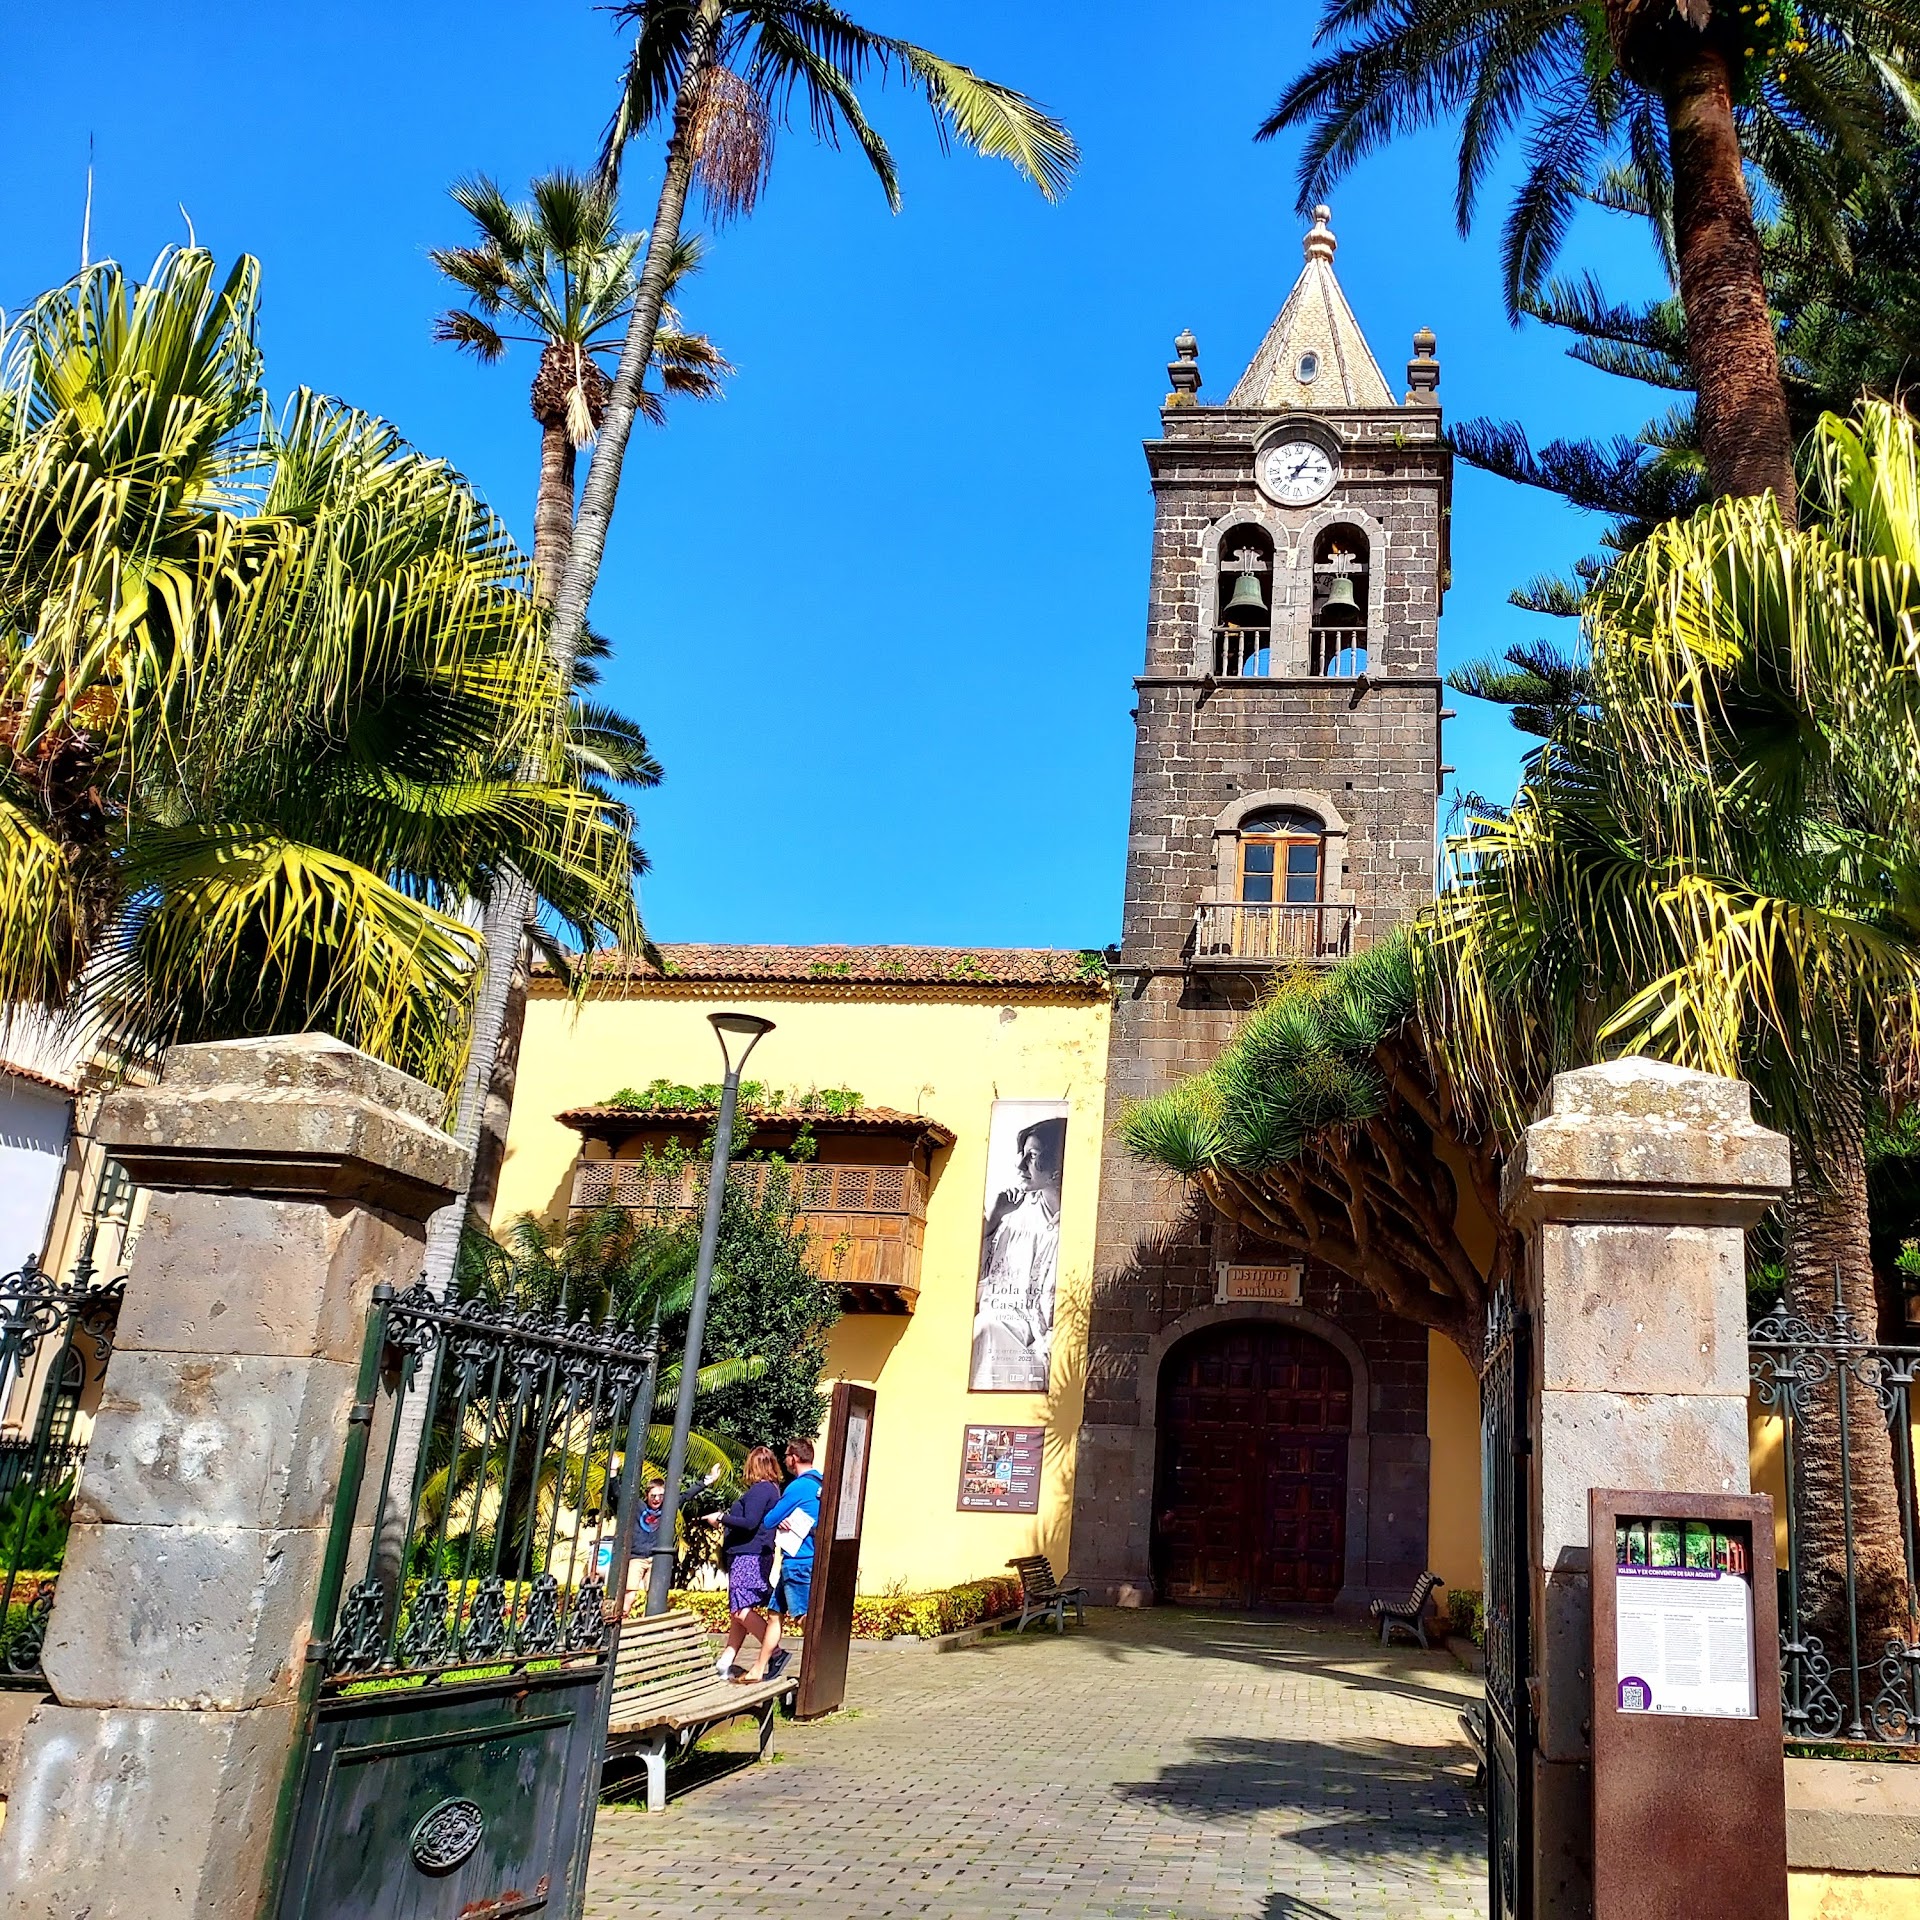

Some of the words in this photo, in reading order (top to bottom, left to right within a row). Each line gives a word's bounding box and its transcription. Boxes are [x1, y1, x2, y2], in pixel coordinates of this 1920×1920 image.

[1233, 1270, 1288, 1281] INSTITUTO
[991, 1283, 1020, 1295] Lola
[1025, 1283, 1044, 1295] del
